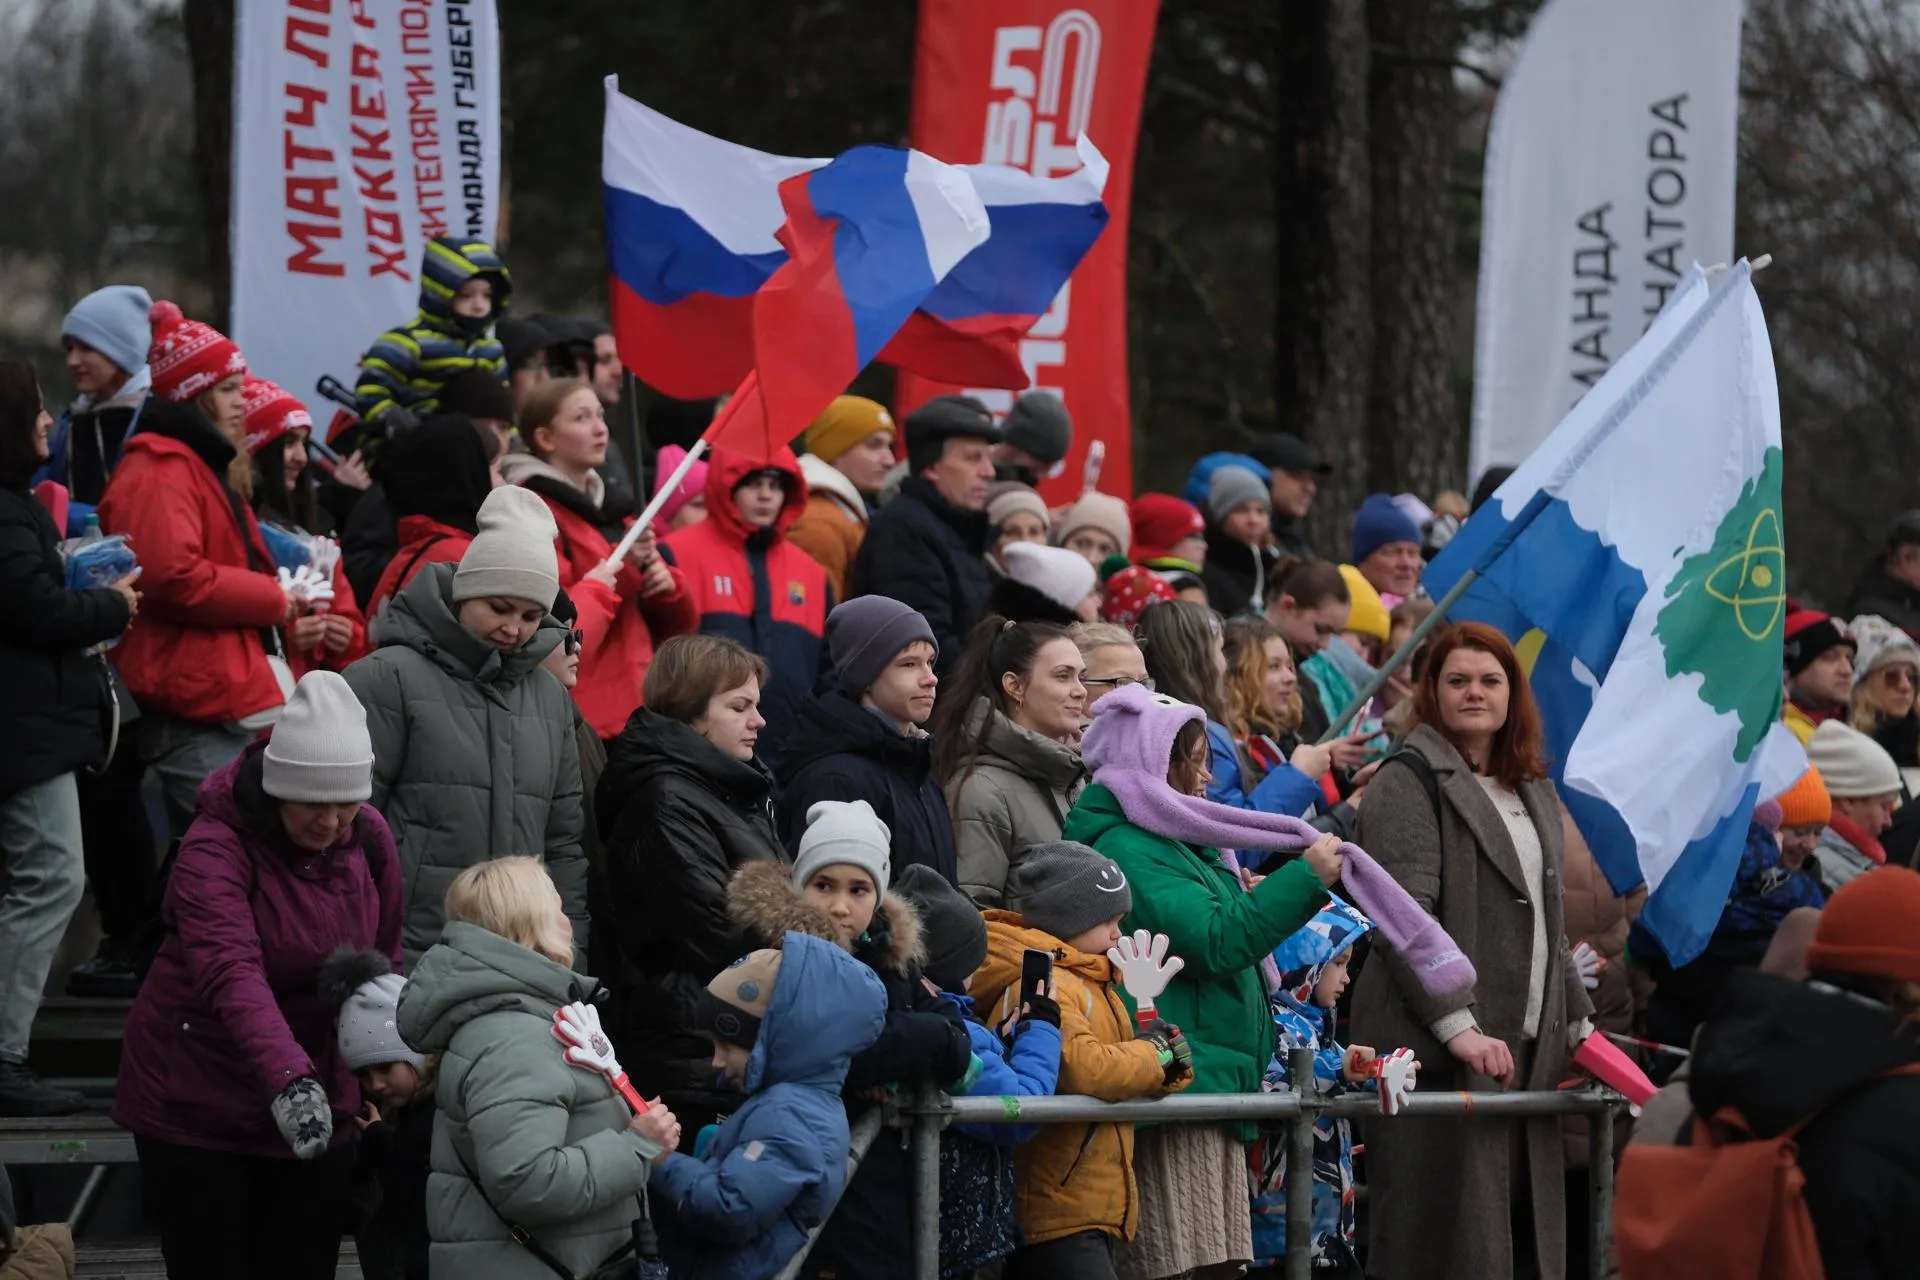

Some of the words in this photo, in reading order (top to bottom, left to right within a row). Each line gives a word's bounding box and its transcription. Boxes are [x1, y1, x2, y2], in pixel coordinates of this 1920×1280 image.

[400, 0, 434, 54] ПО
[446, 0, 477, 109] ГУБЕР
[284, 82, 346, 277] МАТЧ
[351, 43, 412, 282] ХОККЕЯ
[1642, 92, 1690, 334] НАТОРА
